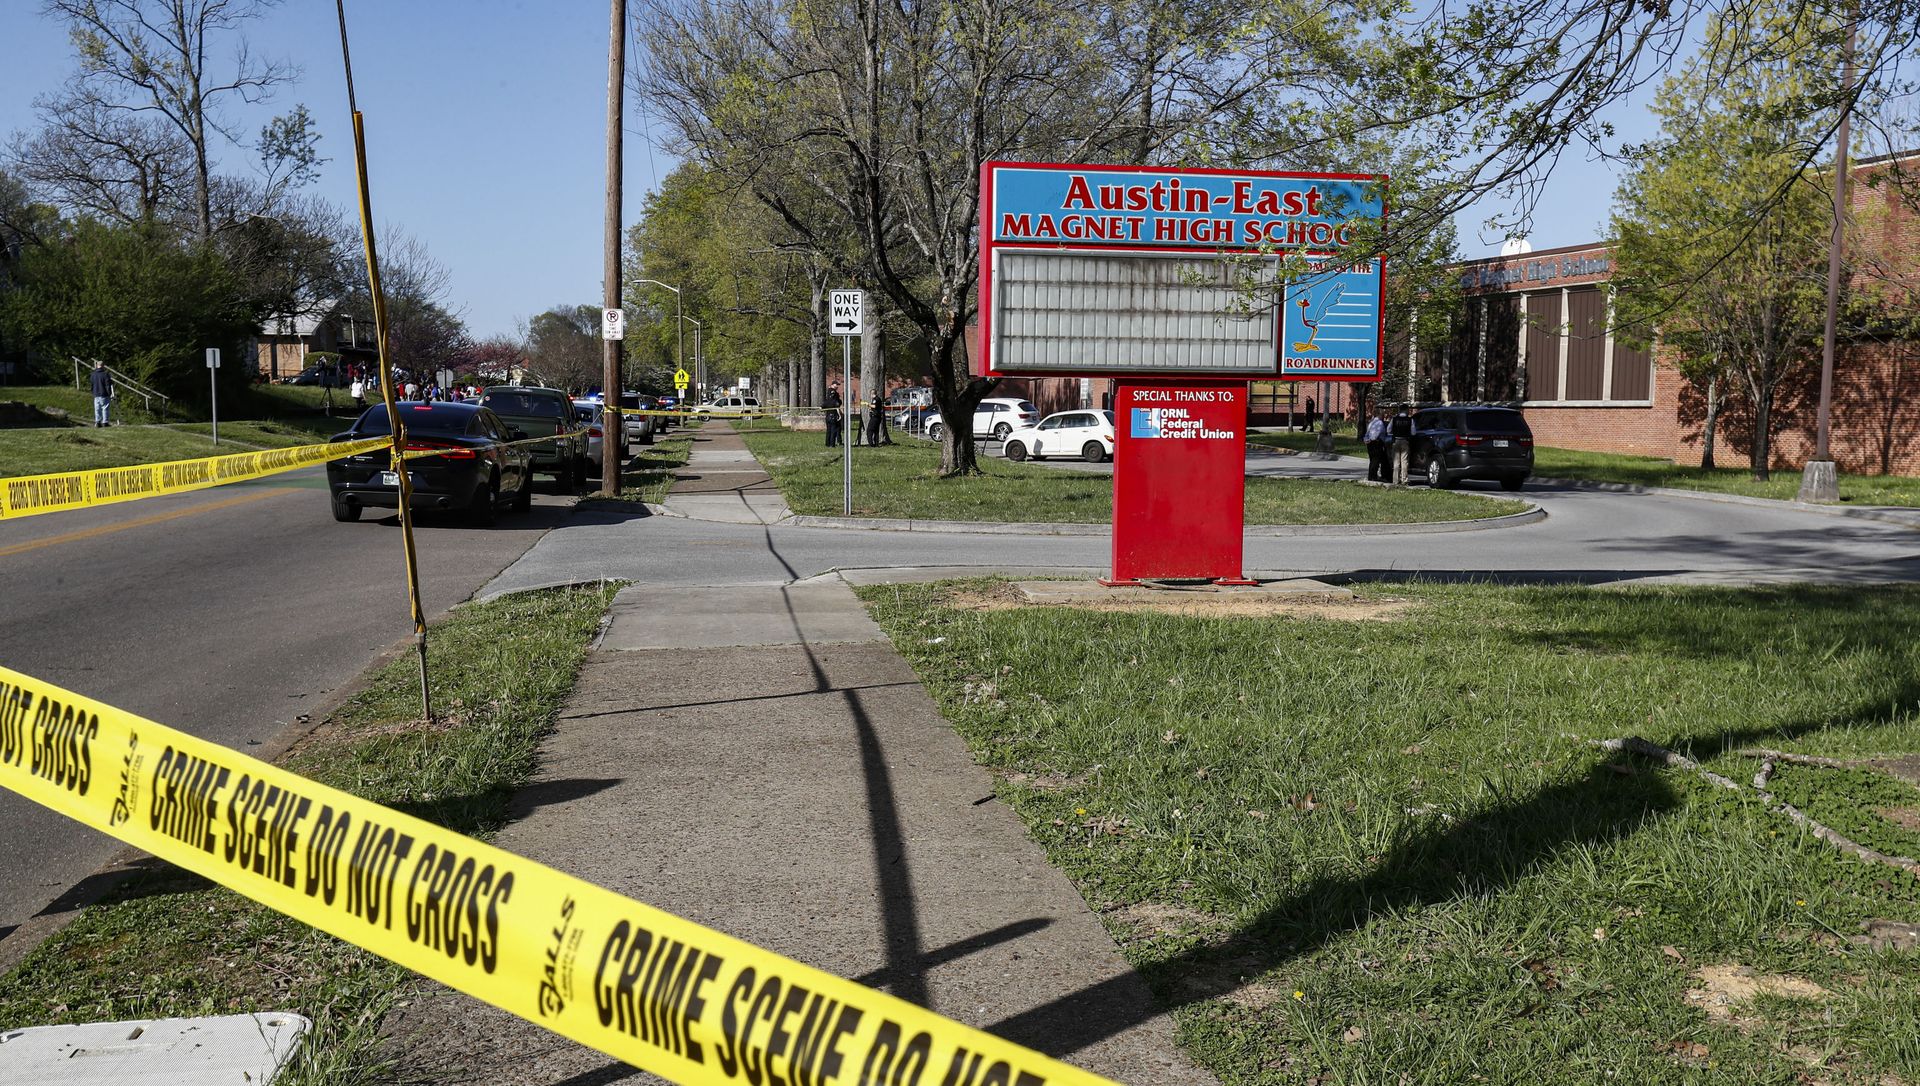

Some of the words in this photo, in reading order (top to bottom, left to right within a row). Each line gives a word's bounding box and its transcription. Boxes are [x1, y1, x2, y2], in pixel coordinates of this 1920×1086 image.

[1061, 175, 1322, 216] Austin-East
[1001, 213, 1145, 240] MAGNET
[1153, 217, 1235, 243] HIGH
[1244, 220, 1360, 247] SCHOO
[834, 294, 859, 305] ONE
[834, 306, 859, 317] WAY
[1285, 356, 1376, 371] ROADRUNNERS
[1133, 390, 1172, 402] SPECIAL
[1174, 390, 1215, 402] THANKS
[1218, 391, 1234, 402] TO:
[1160, 408, 1190, 419] ORNL
[1160, 418, 1203, 429] Federal
[1160, 428, 1197, 439] Credit
[1199, 429, 1234, 439] Union
[31, 695, 99, 797] CROSS
[150, 745, 231, 853] CRIME
[225, 773, 312, 889] SCENE
[304, 804, 351, 905] DO
[347, 816, 414, 931] NOT
[406, 842, 516, 975] CROSS
[593, 919, 725, 1066] CRIME
[715, 965, 865, 1086] SCENE
